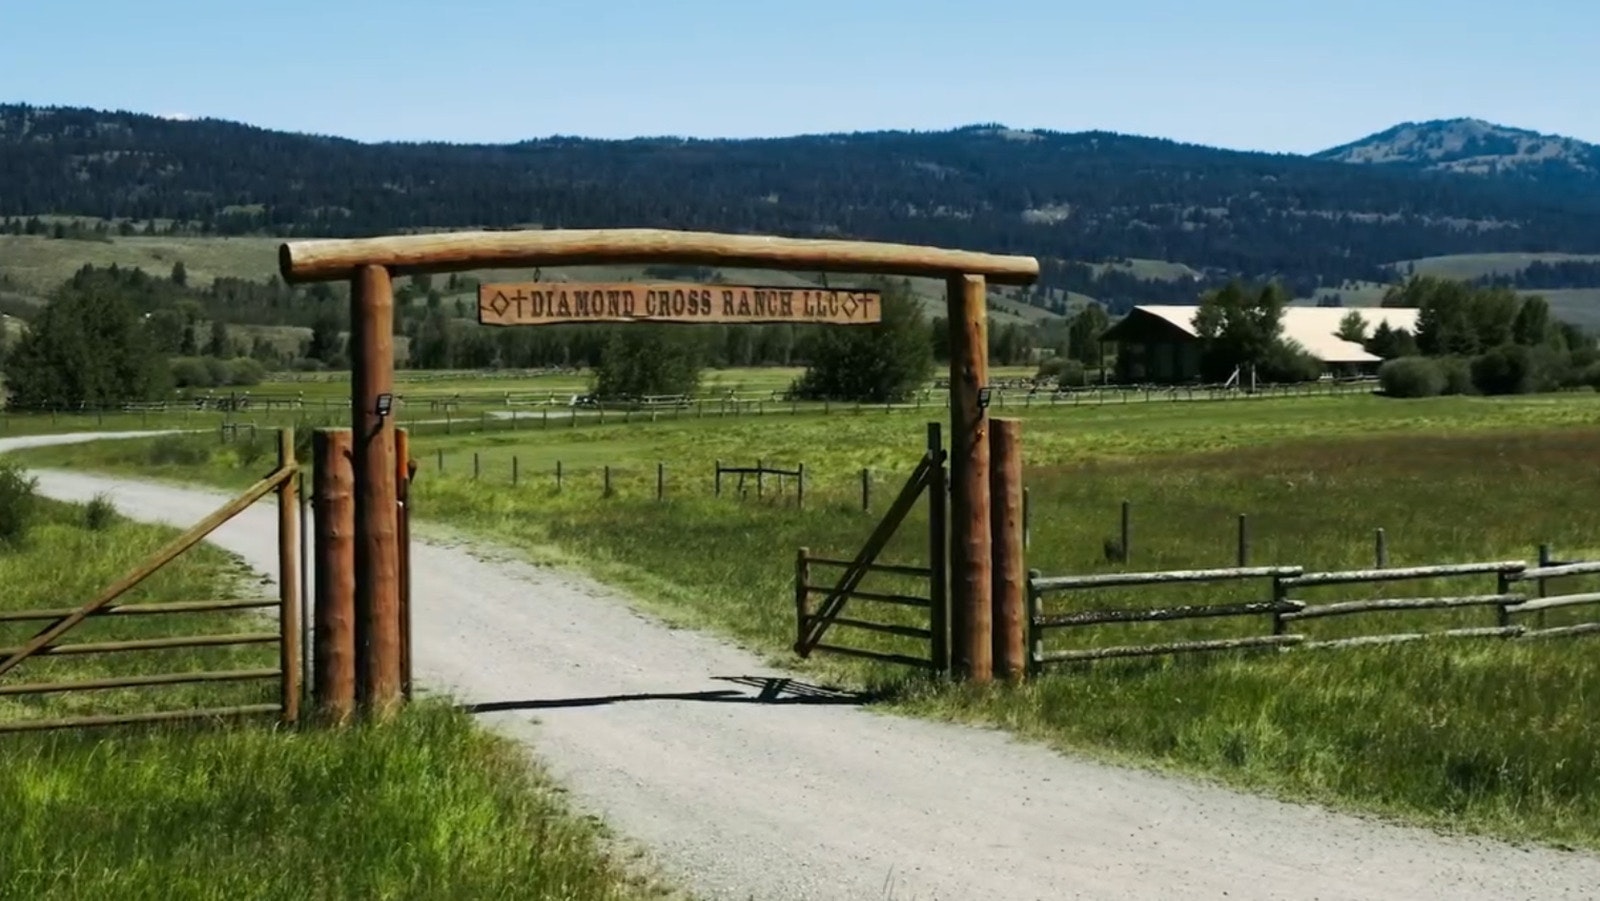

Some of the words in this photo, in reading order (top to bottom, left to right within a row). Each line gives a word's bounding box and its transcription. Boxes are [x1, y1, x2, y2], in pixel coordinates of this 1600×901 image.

[531, 290, 634, 317] DIAMOND
[645, 290, 712, 317] CROSS
[722, 291, 793, 316] RANCH
[803, 291, 839, 316] LLC
